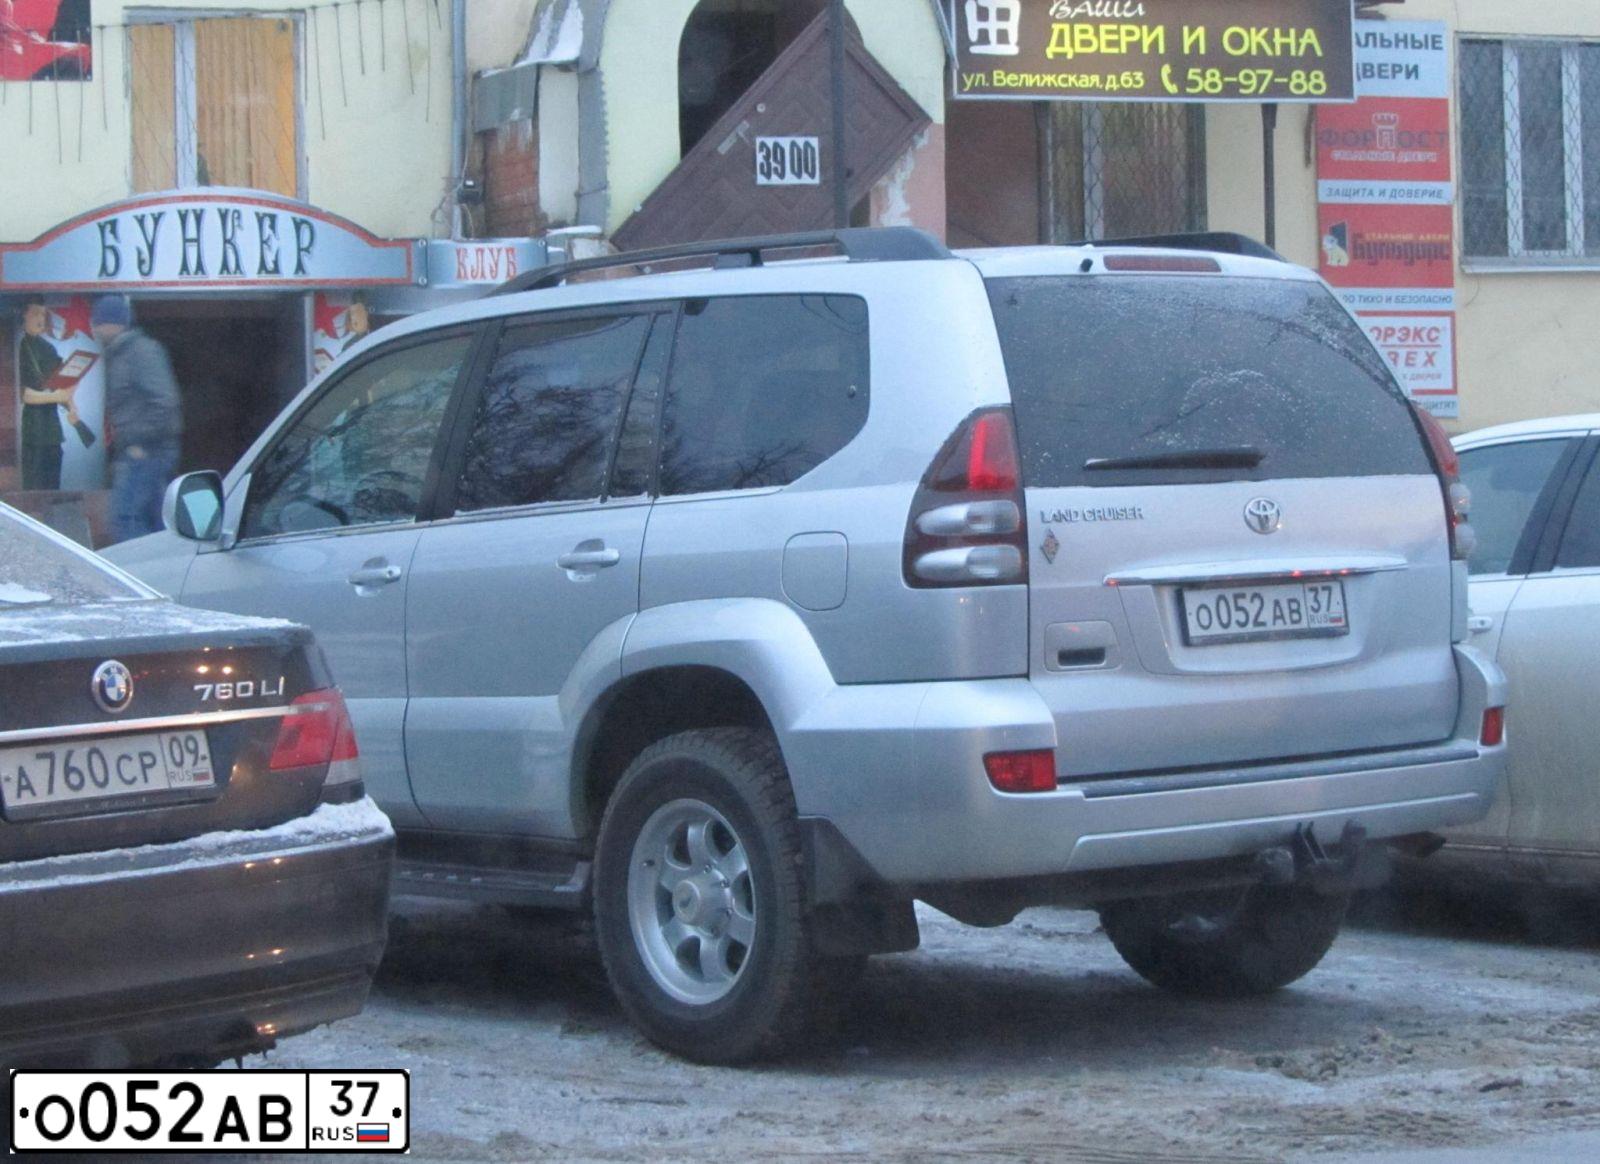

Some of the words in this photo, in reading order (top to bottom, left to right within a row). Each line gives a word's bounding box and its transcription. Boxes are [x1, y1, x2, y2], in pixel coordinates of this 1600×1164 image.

[1046, 23, 1166, 59] ДВЕРИ
[1183, 25, 1206, 55] И
[1222, 26, 1323, 57] ОКНА
[1356, 32, 1443, 50] ЛЬНЫЕ
[1357, 62, 1419, 81] ВЕРИ
[962, 72, 990, 91] ул.
[1186, 68, 1326, 95] 58-97-88
[1326, 187, 1374, 198] ЗАЩИТА
[1378, 188, 1387, 199] И
[1389, 188, 1444, 199] ДОВЕРИЕ
[97, 207, 317, 277] БУНКЕР
[455, 247, 518, 280] КЛУБ
[1359, 295, 1382, 304] ТИХО
[1394, 295, 1453, 304] БЕЗОПАСНО
[1369, 326, 1440, 342] ОРЭКС
[1040, 509, 1080, 523] LAND
[1082, 506, 1144, 522] CRUISER
[1309, 585, 1333, 613] 37
[193, 680, 254, 701] 760
[16, 747, 157, 799] А760СР
[169, 735, 200, 768] 09
[169, 770, 193, 782] RUS
